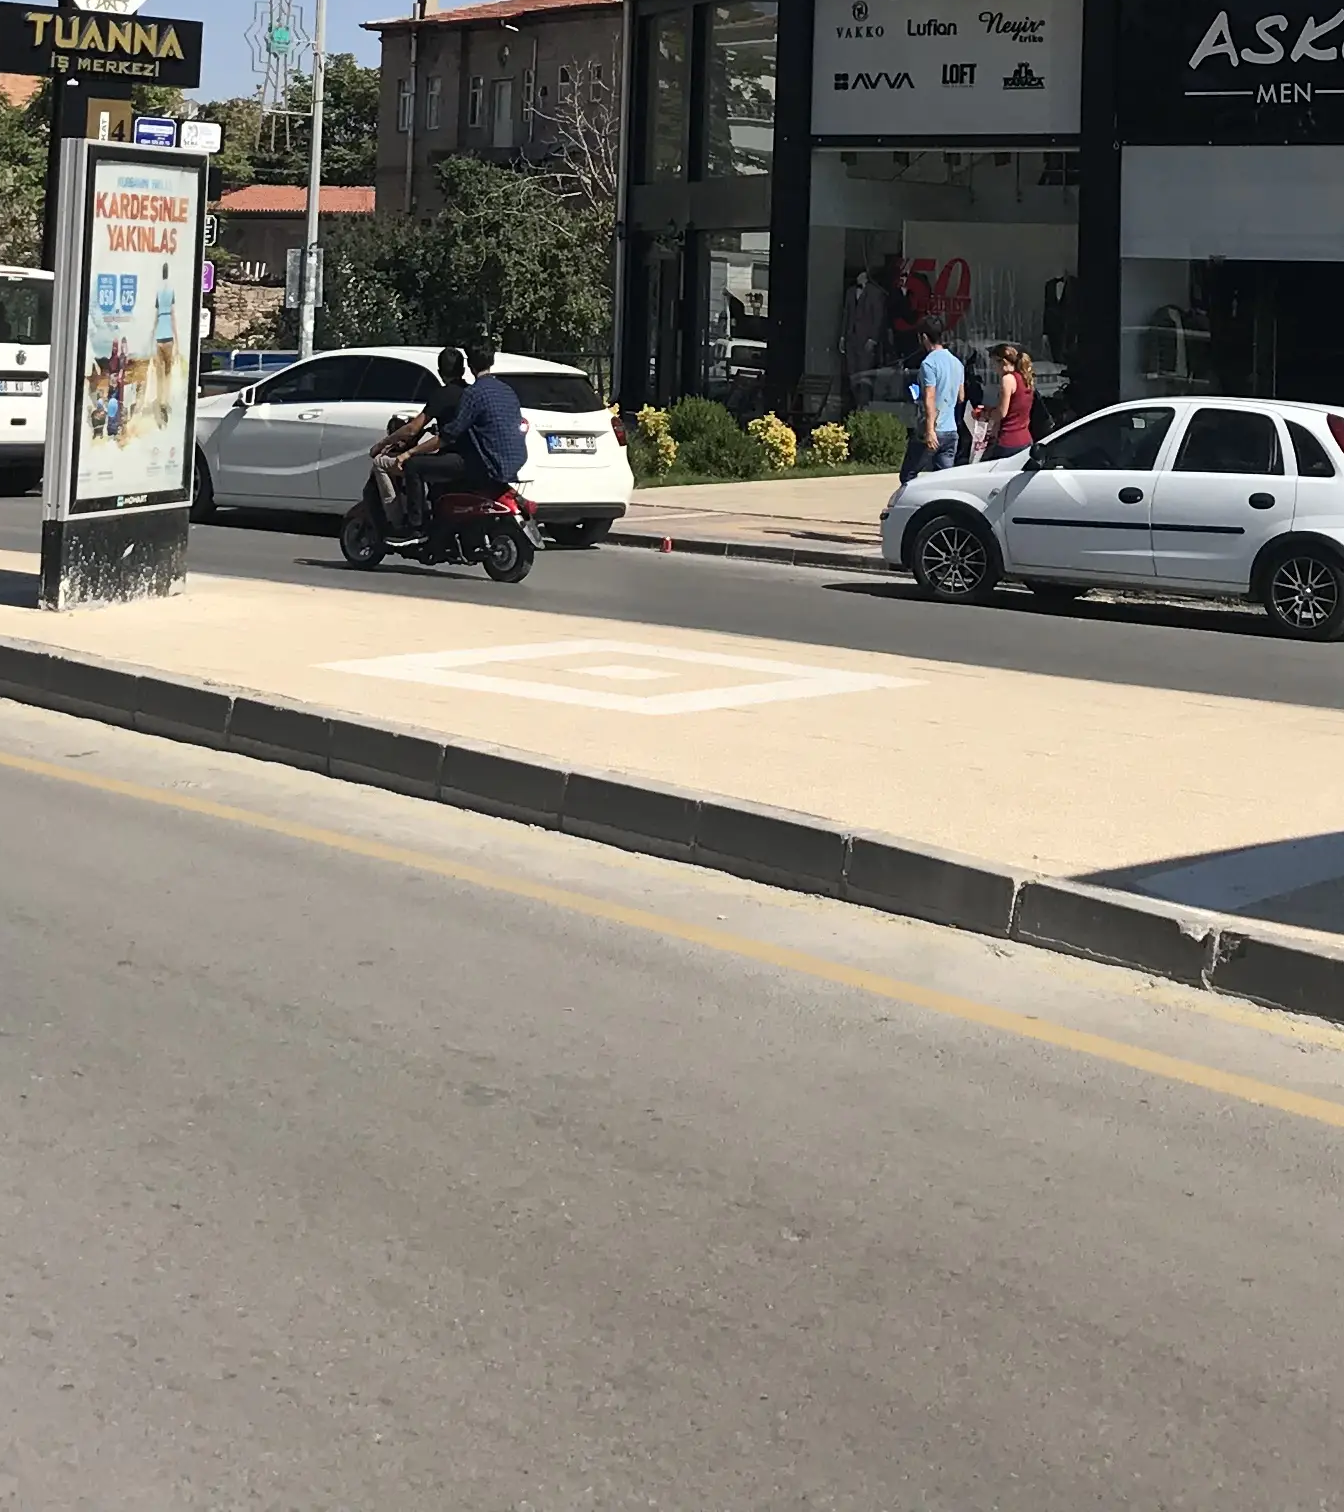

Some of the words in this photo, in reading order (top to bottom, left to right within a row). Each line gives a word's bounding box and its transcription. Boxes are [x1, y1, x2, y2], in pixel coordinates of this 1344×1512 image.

[25, 10, 184, 60] TUANNA
[836, 26, 884, 39] VAKKO
[907, 20, 957, 37] Lufian
[51, 51, 69, 73] İŞ
[77, 56, 159, 77] MERKEZİ
[941, 63, 977, 85] LOFT
[1256, 82, 1311, 103] MEN
[111, 119, 125, 142] 4
[96, 191, 189, 224] KARDEŞİNLE
[107, 224, 177, 255] YAKINLAŞ
